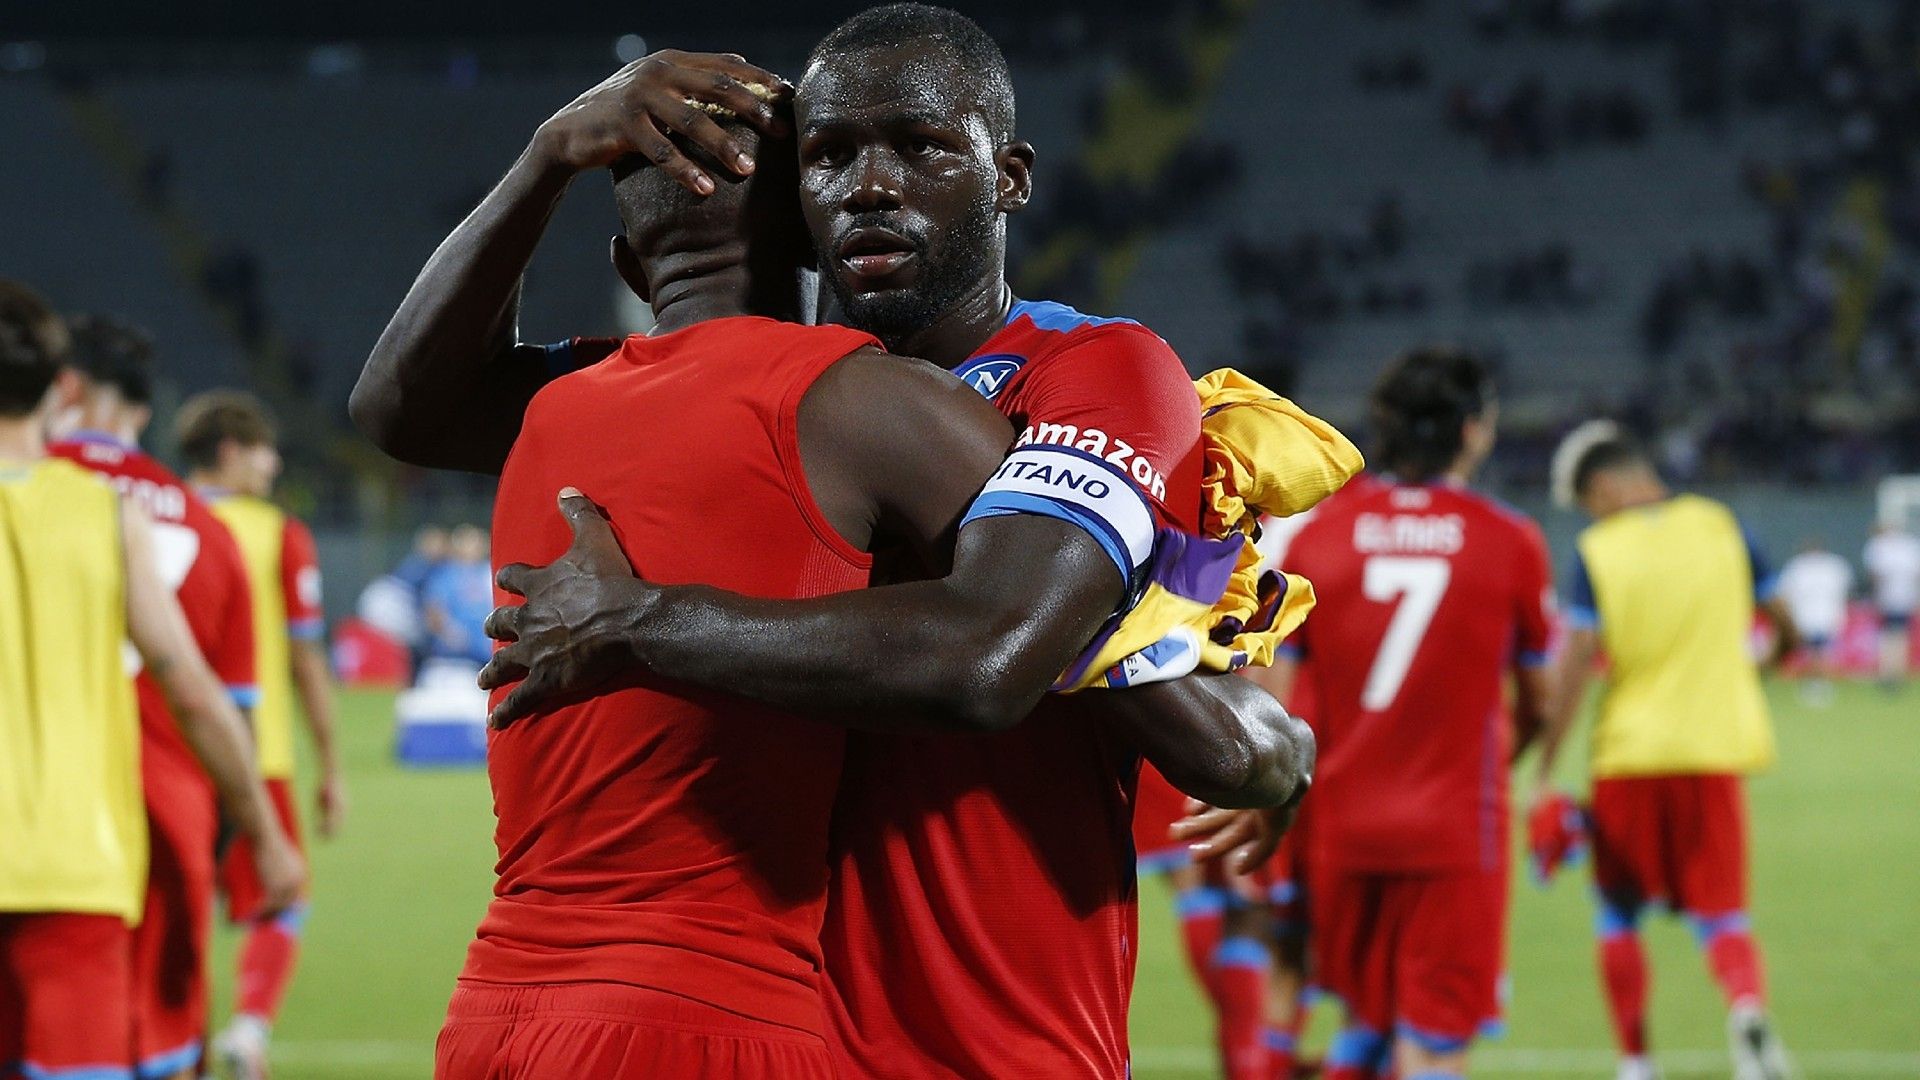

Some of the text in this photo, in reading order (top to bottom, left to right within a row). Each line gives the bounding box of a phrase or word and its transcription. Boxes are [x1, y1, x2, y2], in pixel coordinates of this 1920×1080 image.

[997, 461, 1110, 499] ITANO
[1014, 421, 1168, 502] amazon
[1355, 514, 1464, 553] ELMAS
[1361, 556, 1450, 710] 7
